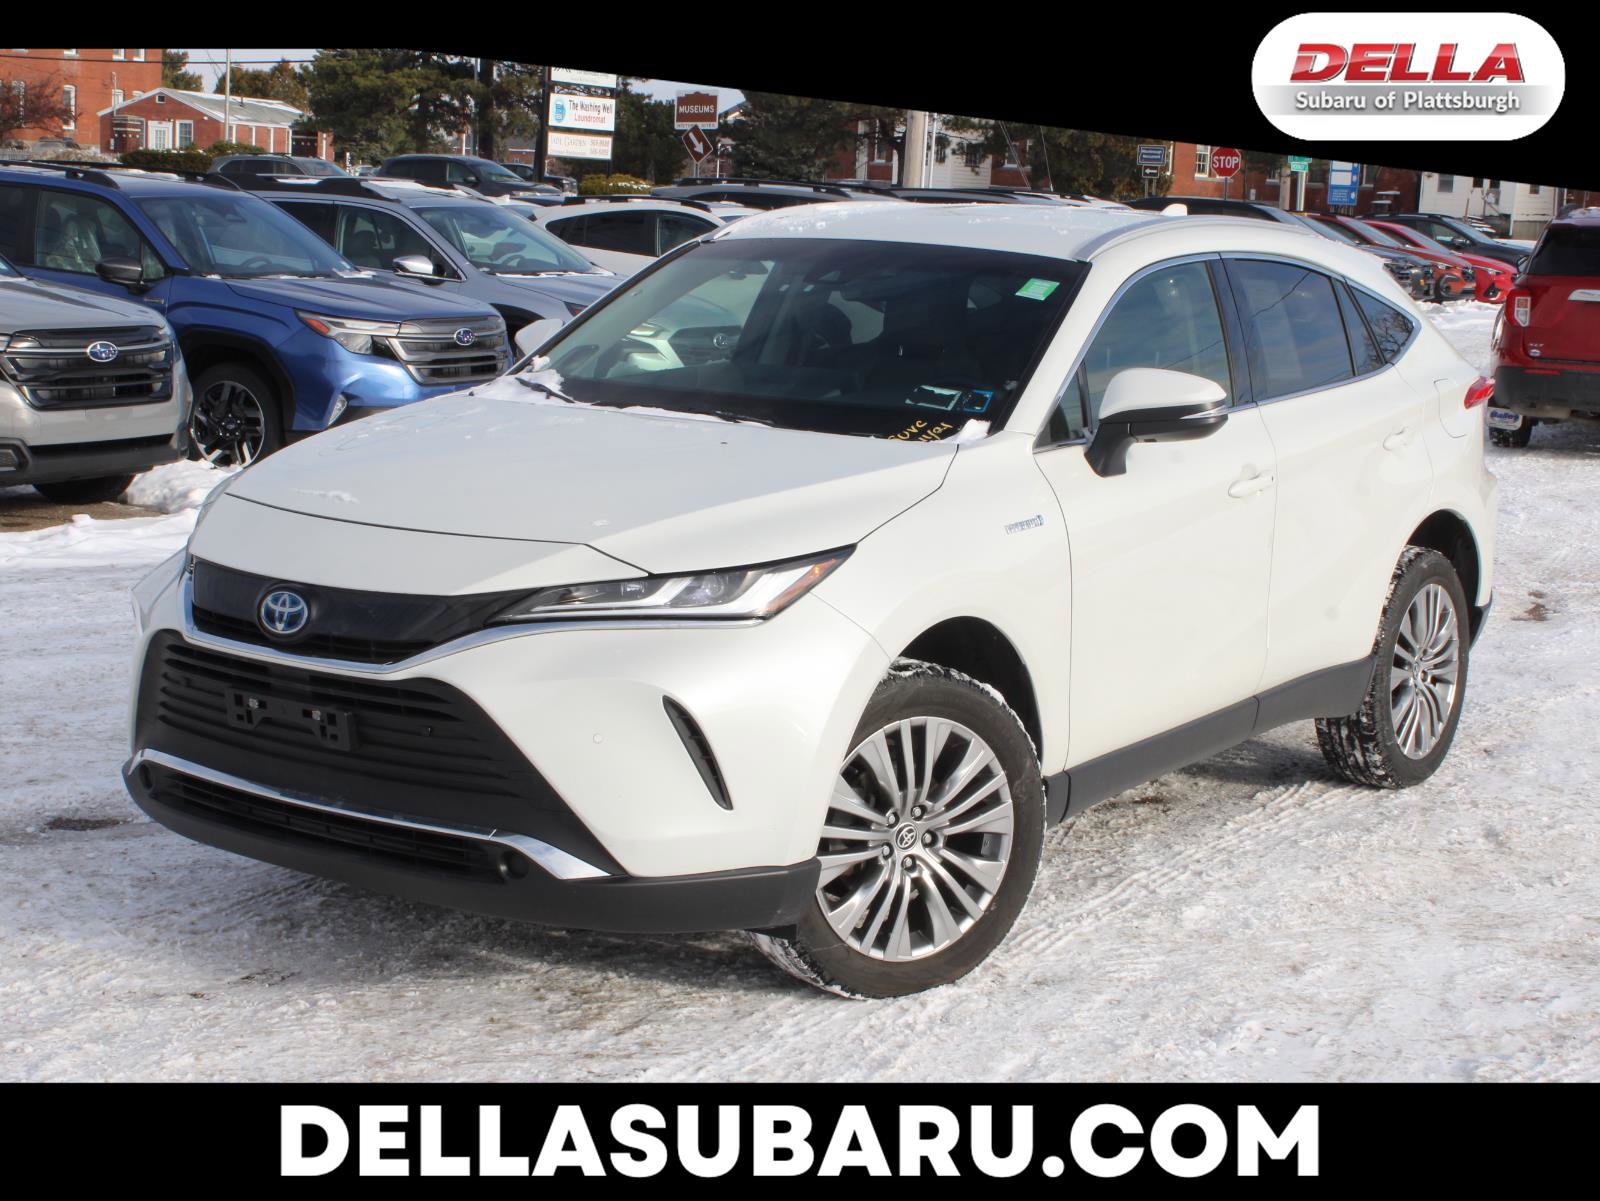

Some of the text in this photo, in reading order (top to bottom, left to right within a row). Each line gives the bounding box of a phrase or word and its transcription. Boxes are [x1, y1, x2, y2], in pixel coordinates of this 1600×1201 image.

[568, 99, 613, 115] The Washing Well
[678, 104, 715, 114] MUSEUMS
[1213, 156, 1239, 168] STOP
